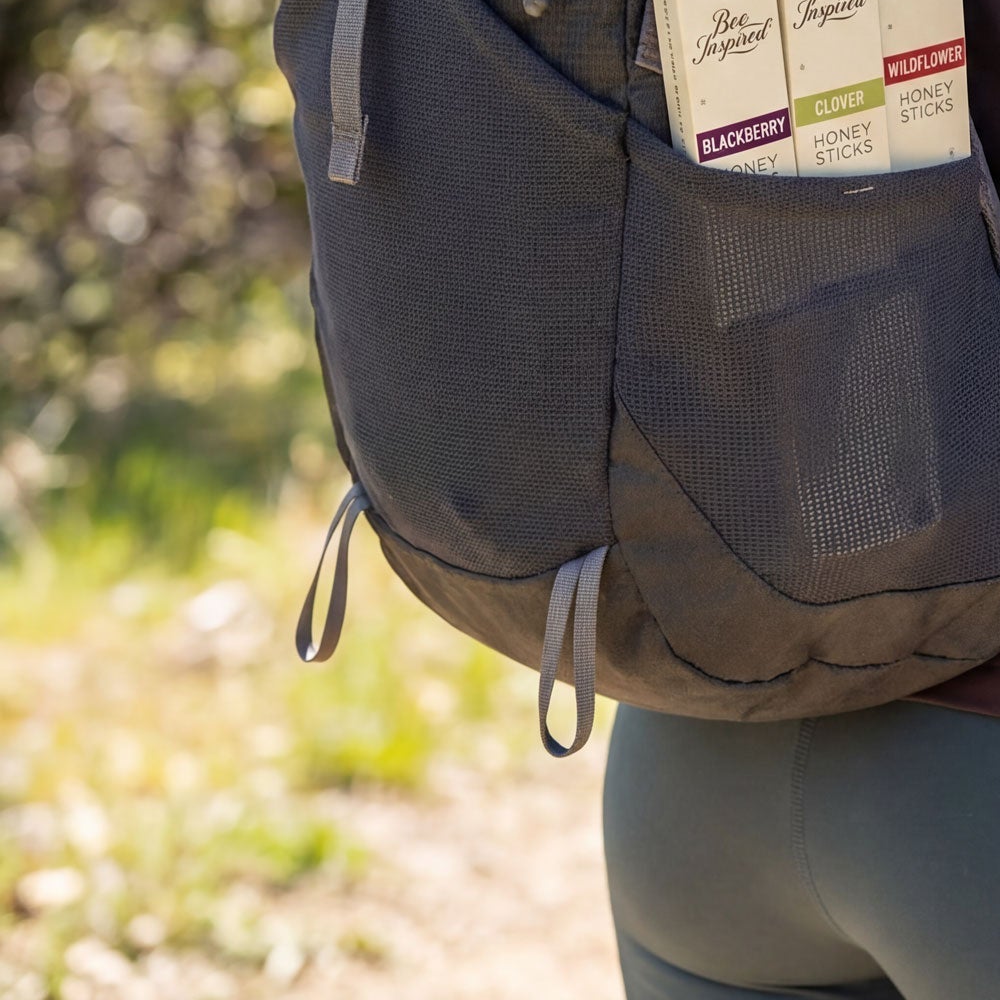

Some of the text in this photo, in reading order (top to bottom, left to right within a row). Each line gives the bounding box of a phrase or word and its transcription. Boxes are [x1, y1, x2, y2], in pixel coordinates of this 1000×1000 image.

[712, 8, 749, 38] Bee
[692, 18, 773, 65] Inspired
[888, 45, 962, 78] WILDFLOWER
[815, 90, 864, 116] CLOVER
[900, 80, 953, 106] HONEY
[901, 98, 954, 123] STICKS
[702, 116, 785, 154] BLACKBERRY
[814, 121, 871, 148] HONEY
[725, 153, 778, 174] ONEY
[816, 139, 873, 165] STICKS
